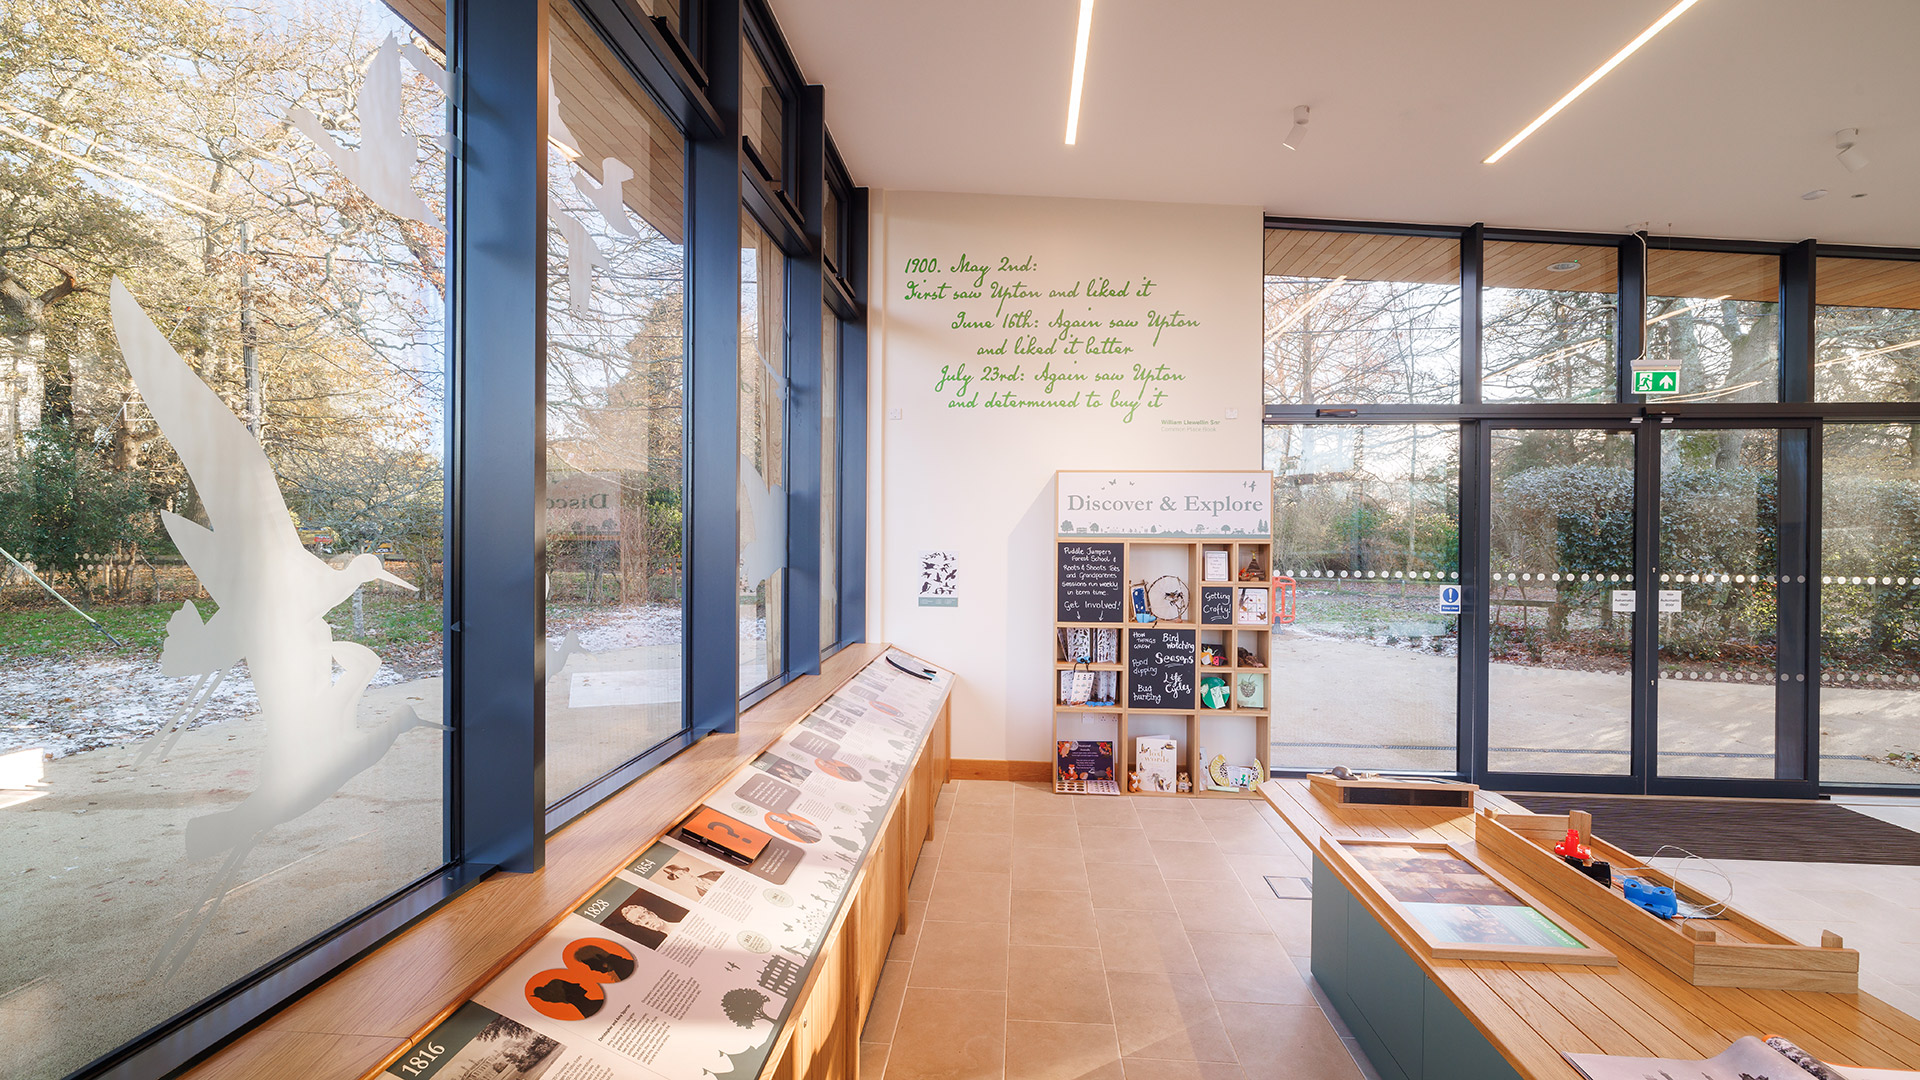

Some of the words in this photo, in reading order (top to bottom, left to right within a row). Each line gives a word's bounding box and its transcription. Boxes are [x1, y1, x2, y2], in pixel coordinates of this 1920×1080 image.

[905, 257, 941, 273] 1900.
[950, 253, 991, 288] May
[998, 255, 1037, 272] 2nd:
[904, 280, 952, 300] First
[953, 290, 982, 299] saw
[990, 281, 1042, 318] Upton
[1049, 281, 1080, 298] and
[1086, 277, 1130, 298] liked
[1136, 276, 1157, 297] it
[951, 311, 995, 330] June
[1002, 309, 1039, 329] 16th:
[1048, 307, 1102, 341] Again
[1109, 319, 1138, 328] saw
[1147, 310, 1200, 347] Upton
[977, 338, 1008, 355] and
[1014, 334, 1057, 355] liked
[1063, 334, 1084, 354] it
[1085, 336, 1134, 354] better
[934, 363, 974, 397] July
[980, 365, 1024, 381] 23rd:
[1034, 360, 1088, 394] Again
[1095, 373, 1124, 381] saw
[1133, 363, 1186, 400] Upton
[948, 392, 979, 408] and
[984, 389, 1080, 408] determined
[1085, 391, 1103, 408] to
[1110, 389, 1141, 424] buy
[1147, 387, 1169, 408] it
[1067, 495, 1153, 511] Discover
[1159, 496, 1177, 511] &
[1184, 496, 1263, 517] Explore
[1063, 547, 1084, 555] Puddle
[1086, 547, 1111, 556] Jumpers
[1086, 563, 1107, 571] Shoots
[1079, 571, 1117, 580] Grandparents
[1099, 581, 1118, 590] weekly
[1064, 600, 1080, 611] Get
[1085, 600, 1121, 610] Involved!
[1205, 592, 1230, 605] Getting
[1203, 602, 1231, 619] Crafty!
[1162, 632, 1179, 643] Bird
[1132, 657, 1149, 667] Pond
[1155, 651, 1194, 664] Seasons
[1133, 667, 1158, 677] dipping
[1137, 684, 1152, 694] Bug
[1132, 692, 1161, 704] hunting
[707, 821, 752, 844] ?
[634, 858, 656, 875] 1854
[583, 899, 610, 919] 1828
[402, 1041, 445, 1077] 1816
